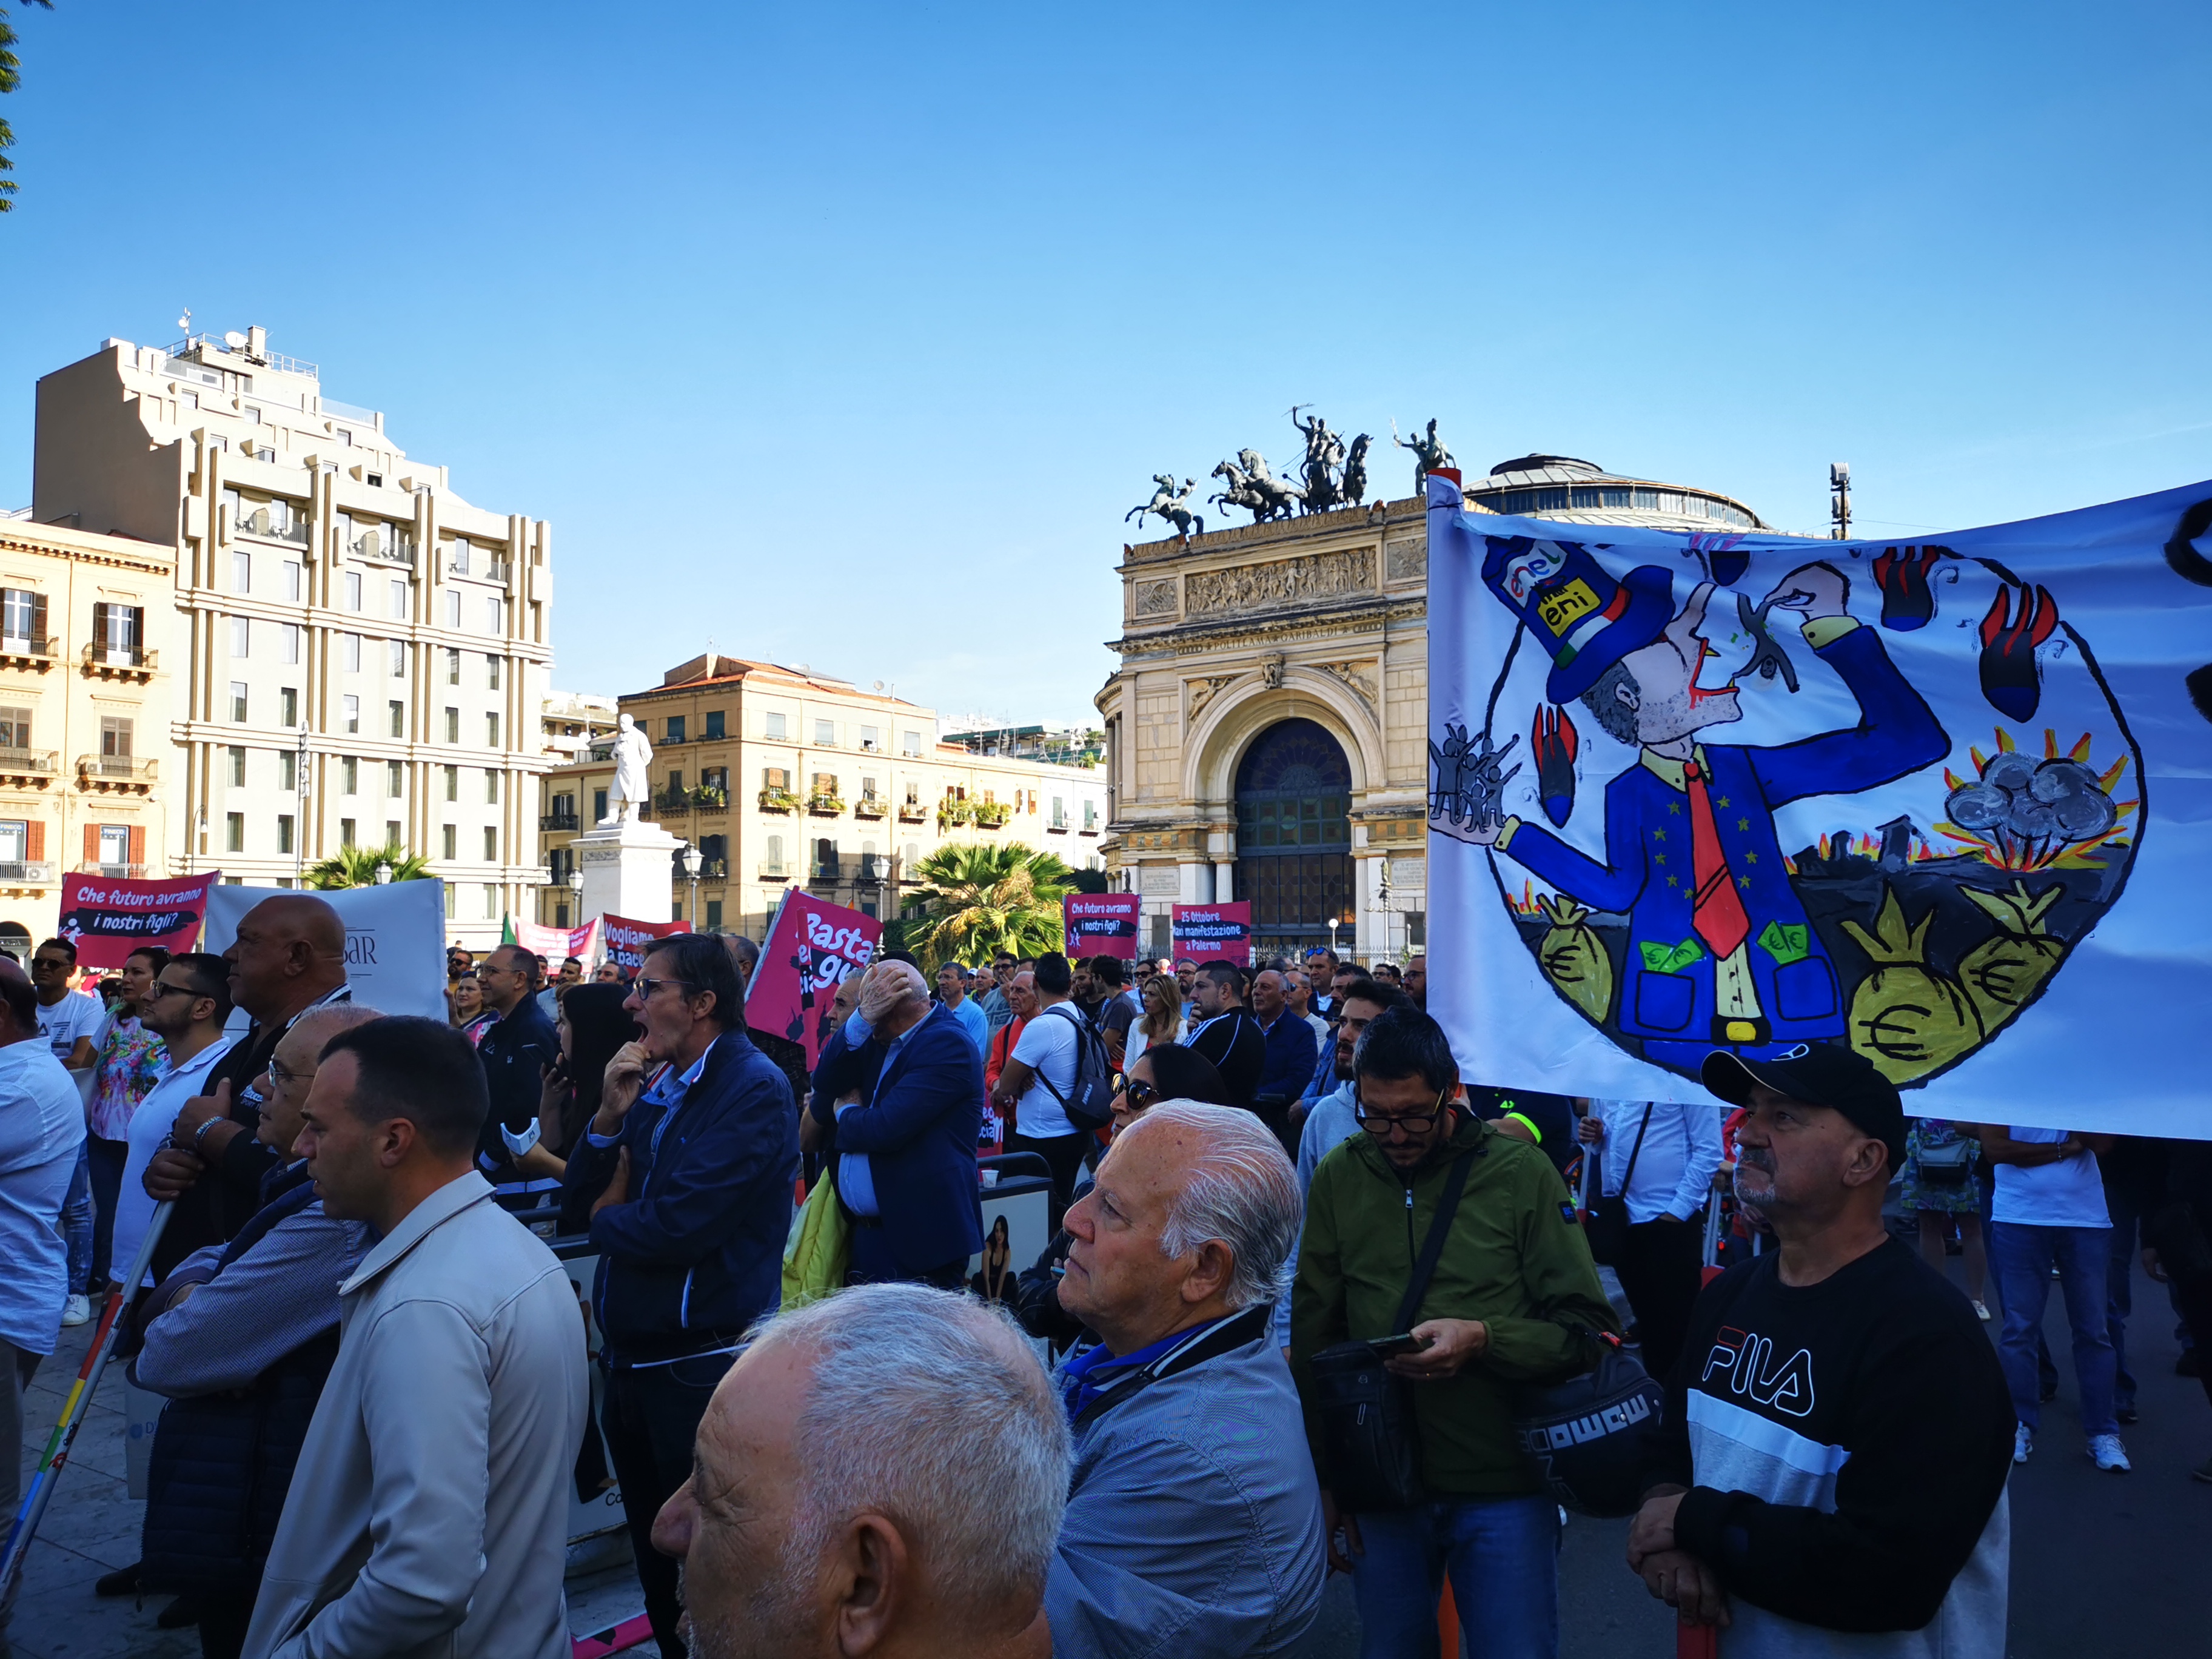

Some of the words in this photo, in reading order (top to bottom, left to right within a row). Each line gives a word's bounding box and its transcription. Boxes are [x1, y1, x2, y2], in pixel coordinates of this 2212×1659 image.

[1510, 548, 1561, 598] enel
[1546, 591, 1589, 626] eni
[1281, 628, 1338, 642] GARIBALDI
[77, 886, 106, 903] Che
[109, 890, 154, 906] futuro
[155, 887, 202, 905] avranno
[1071, 903, 1084, 914] Che
[1084, 902, 1105, 914] futuro
[1105, 903, 1131, 914] avranno
[93, 913, 101, 927] i
[102, 914, 145, 930] nostri
[146, 912, 178, 934] figli?
[1181, 911, 1190, 922] 25
[1190, 910, 1221, 923] Ottobre
[1085, 920, 1104, 931] nostri
[1104, 919, 1121, 934] figli?
[1185, 924, 1241, 936] manifestazione
[1185, 942, 1191, 951] a
[1191, 939, 1221, 951] Palermo
[618, 951, 645, 968] pace
[1702, 1326, 1814, 1416] FILA
